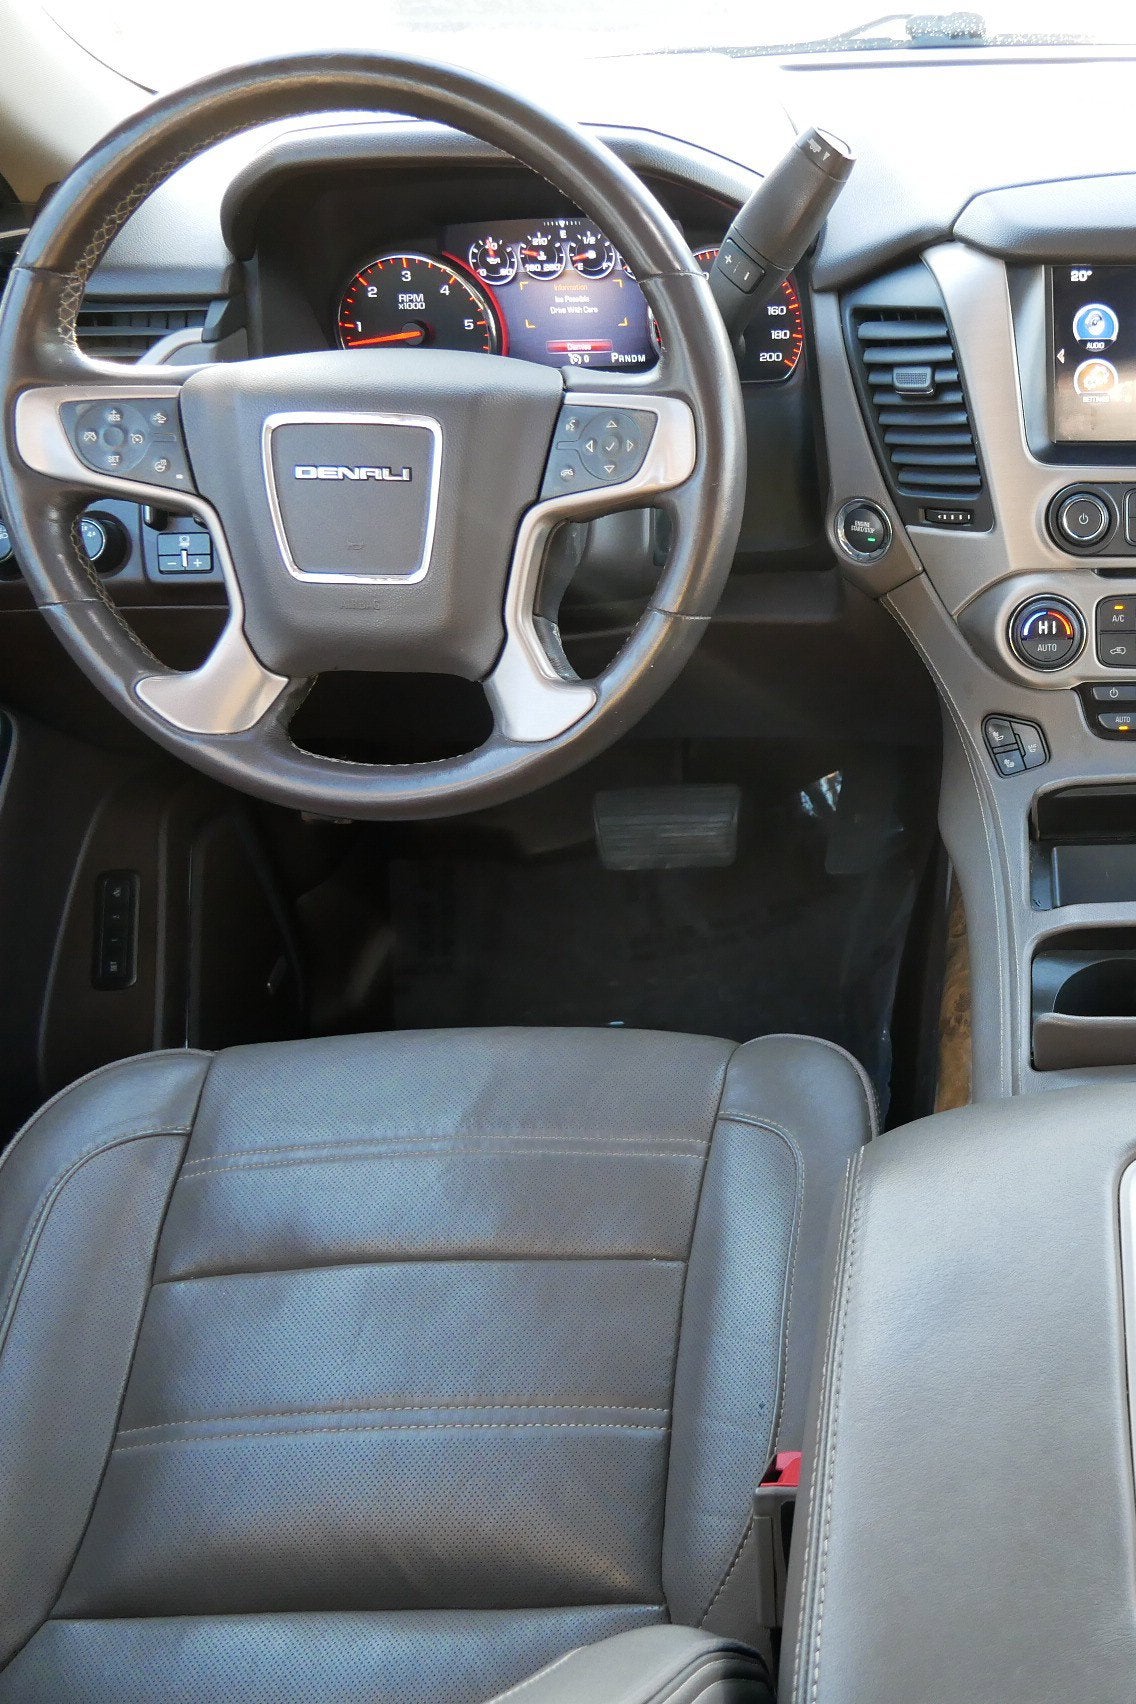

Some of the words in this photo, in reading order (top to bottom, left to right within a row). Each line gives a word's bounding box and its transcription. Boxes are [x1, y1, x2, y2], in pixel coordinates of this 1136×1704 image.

[532, 238, 548, 246] 210
[401, 270, 412, 281] 3
[367, 286, 378, 297] 2
[440, 285, 450, 295] 4
[398, 293, 424, 302] RPM
[398, 302, 426, 310] x1000
[550, 306, 567, 314] Drive
[567, 306, 582, 314] With
[767, 306, 787, 315] 160
[356, 321, 362, 332] 1
[464, 319, 474, 329] 5
[770, 330, 790, 340] 180
[1086, 341, 1105, 349] AUDIO
[759, 352, 783, 362] 200
[1082, 395, 1110, 403] SETTINGS
[294, 465, 412, 481] DENALI
[1111, 613, 1125, 623] A/C
[1037, 620, 1058, 635] HI
[1036, 643, 1058, 653] AUTO
[1115, 715, 1131, 723] AUTO
